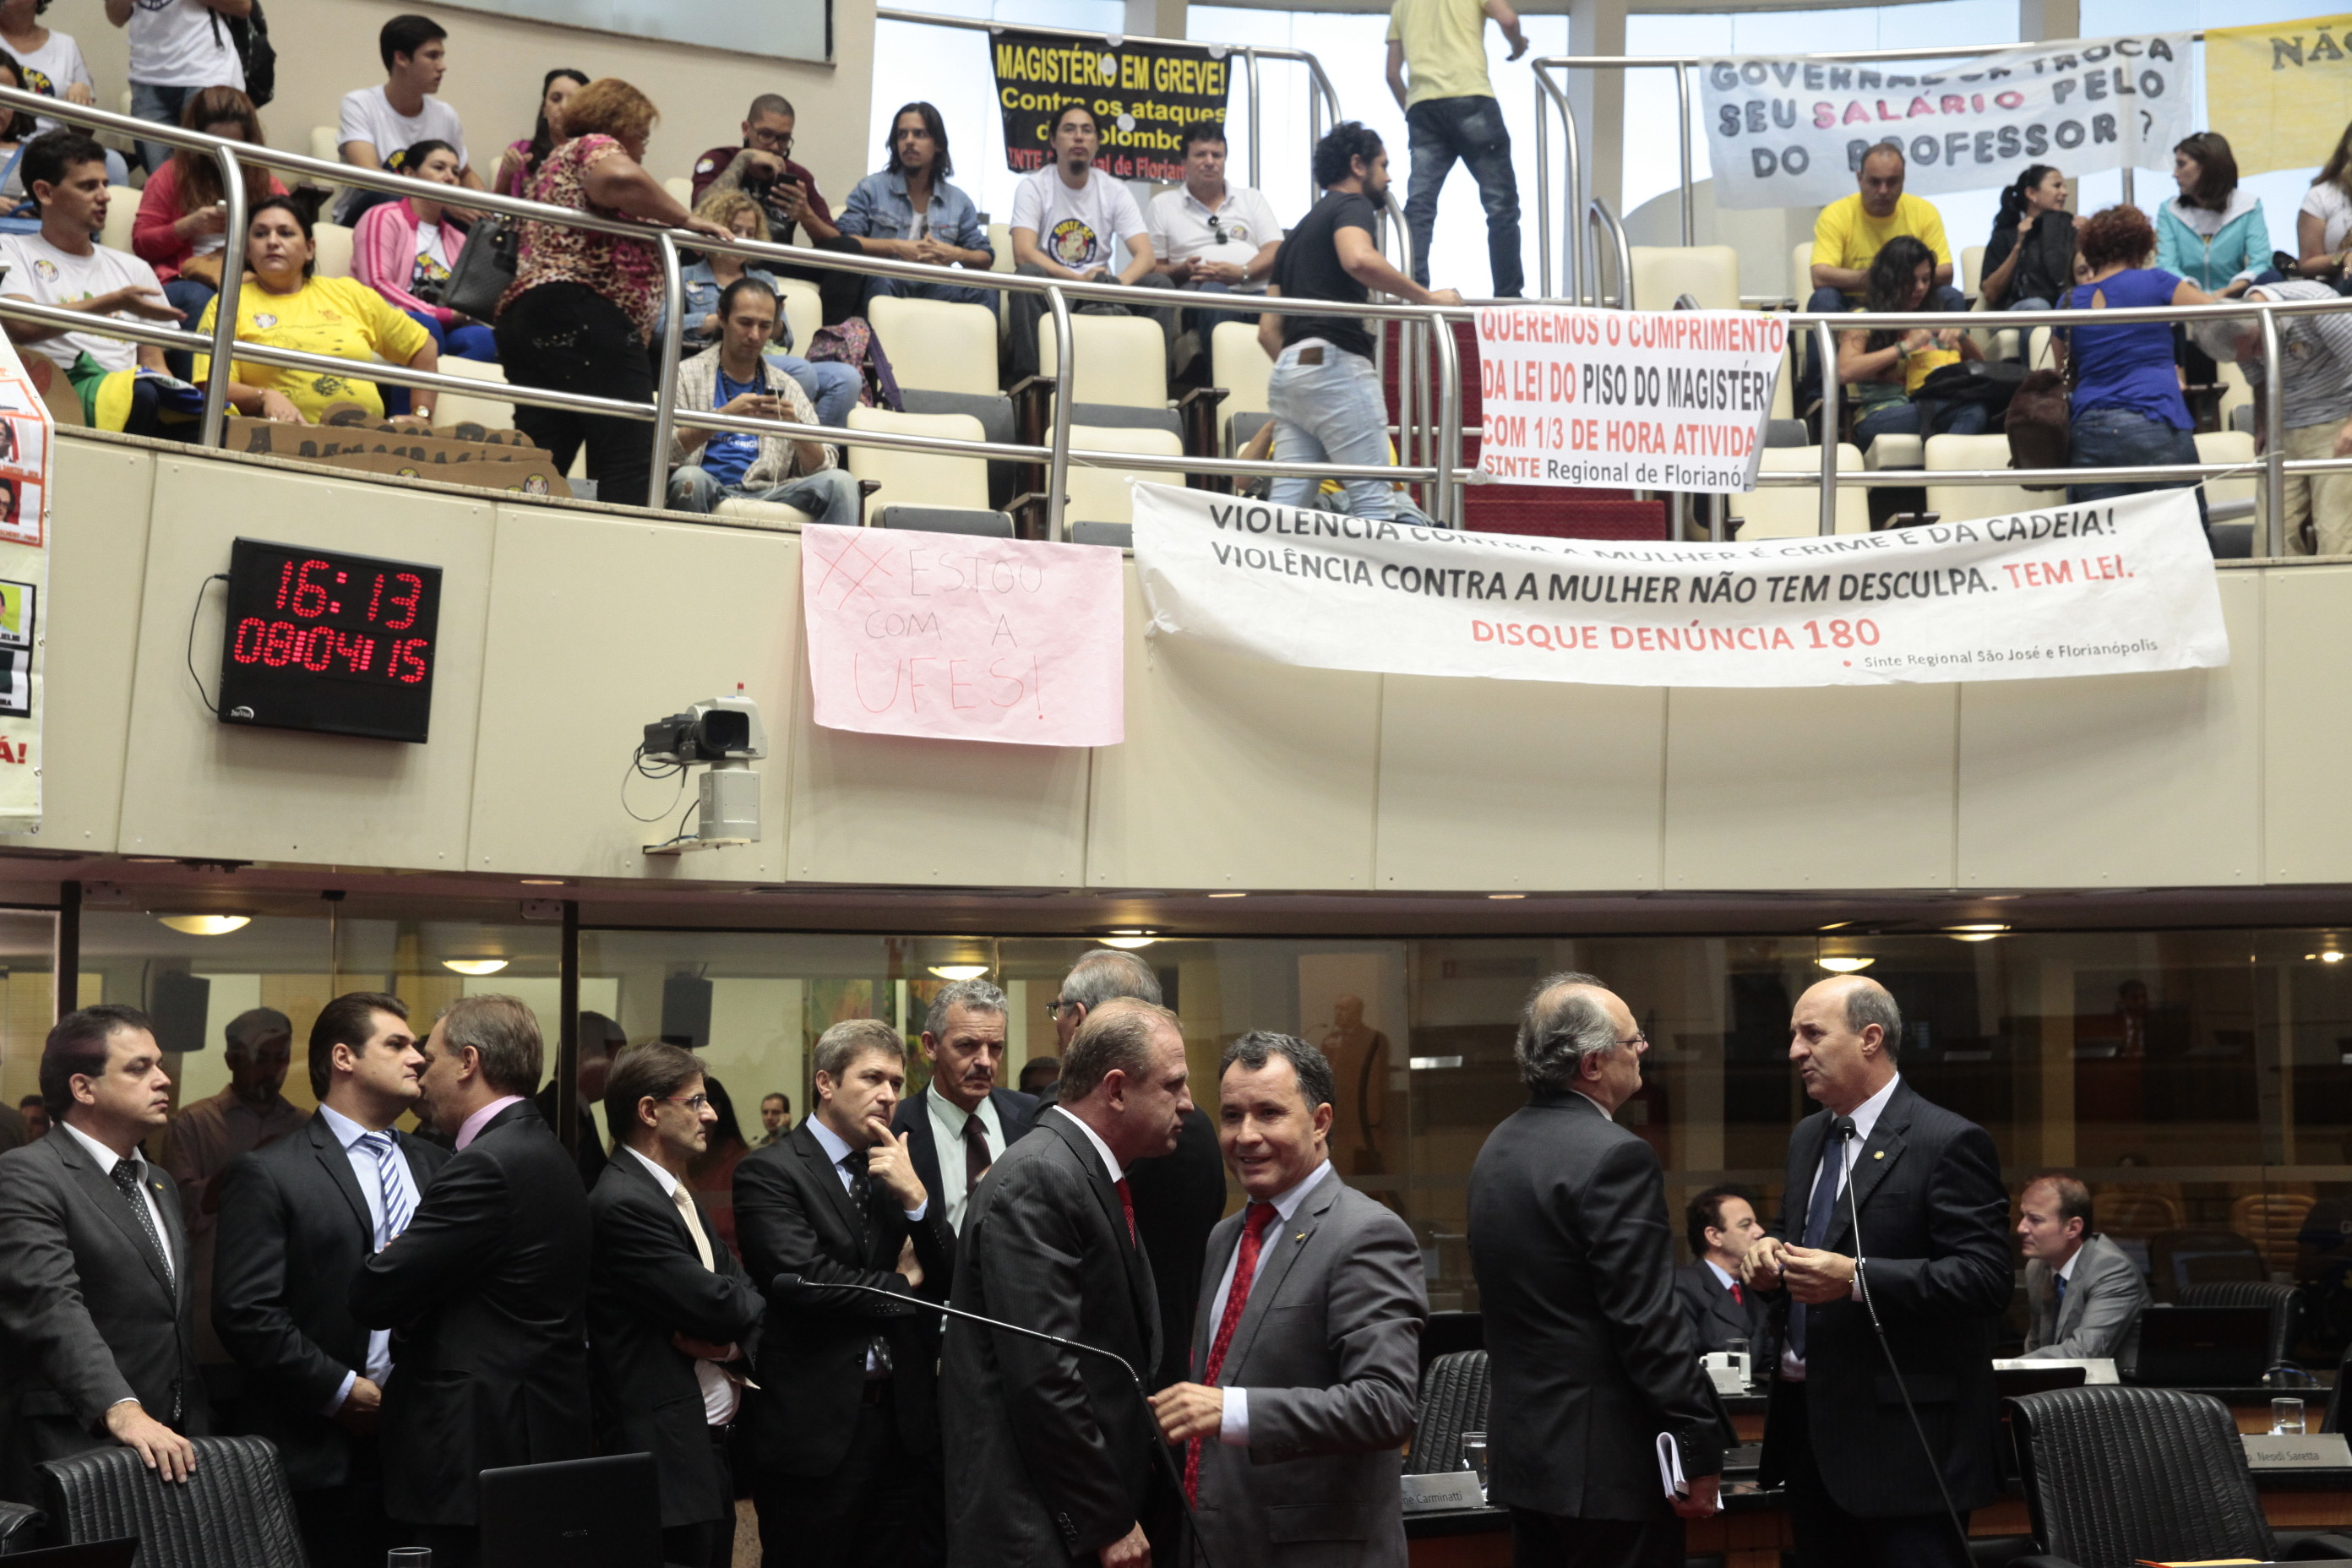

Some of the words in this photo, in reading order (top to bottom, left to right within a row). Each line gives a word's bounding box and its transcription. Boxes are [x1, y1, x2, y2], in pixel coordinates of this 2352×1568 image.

[2031, 38, 2173, 74] TROCA
[1121, 54, 1150, 90] EM
[1154, 57, 1226, 95] GREVE!
[1093, 99, 1124, 117] os
[1131, 101, 1226, 127] ataques
[1718, 99, 1796, 137] SEU
[1813, 89, 2024, 129] SALÁRIO
[2052, 67, 2164, 104] PELO
[1114, 155, 1134, 176] de
[1136, 156, 1186, 181] Florian
[1751, 144, 1810, 178] DO
[1481, 307, 1599, 346] QUEREMOS
[1605, 313, 1621, 346] O
[1628, 315, 1783, 353] CUMPRIMENTO
[1483, 359, 1506, 400] DA
[1513, 359, 1543, 402] LEI
[1549, 362, 1576, 403] DO
[1582, 362, 1627, 406] PISO
[1634, 365, 1660, 407] DO
[1482, 413, 1527, 449] COM
[1533, 416, 1564, 450] 1/3
[1571, 418, 1598, 451] DE
[1607, 420, 1666, 455] HORA
[1484, 454, 1540, 478] SINTE
[1548, 459, 1628, 484] Regional
[1636, 463, 1658, 482] de
[1665, 464, 1748, 487] Florianó
[1593, 550, 1738, 563] MULHER
[1780, 533, 1890, 557] CRIME
[1987, 508, 2116, 542] CADEIA!
[1211, 542, 1373, 587] VIOLÊNCIA
[1381, 564, 1507, 601] CONTRA
[1515, 572, 1539, 602] A
[1549, 573, 1682, 603] MULHER
[1690, 570, 1757, 604] NÃO
[1766, 574, 1831, 602] TEM
[1838, 568, 1998, 601] DESCULPA.
[2002, 559, 2073, 590] TEM
[2081, 554, 2135, 581] LEI.
[865, 609, 942, 641] COM
[991, 613, 1018, 648] A
[1473, 619, 1599, 651] DISQUE
[1610, 618, 1794, 651] DENÚNCIA
[1802, 618, 1881, 649] 180
[1865, 655, 1903, 668] Sinte
[1908, 650, 1973, 667] Regional
[1977, 648, 2004, 662] São
[2008, 645, 2041, 661] José
[2045, 649, 2055, 659] e
[2058, 638, 2159, 658] Florianópolis
[2257, 1451, 2285, 1462] Neodi
[2287, 1451, 2320, 1462] Saretta
[1416, 1490, 1463, 1504] Carminatti
